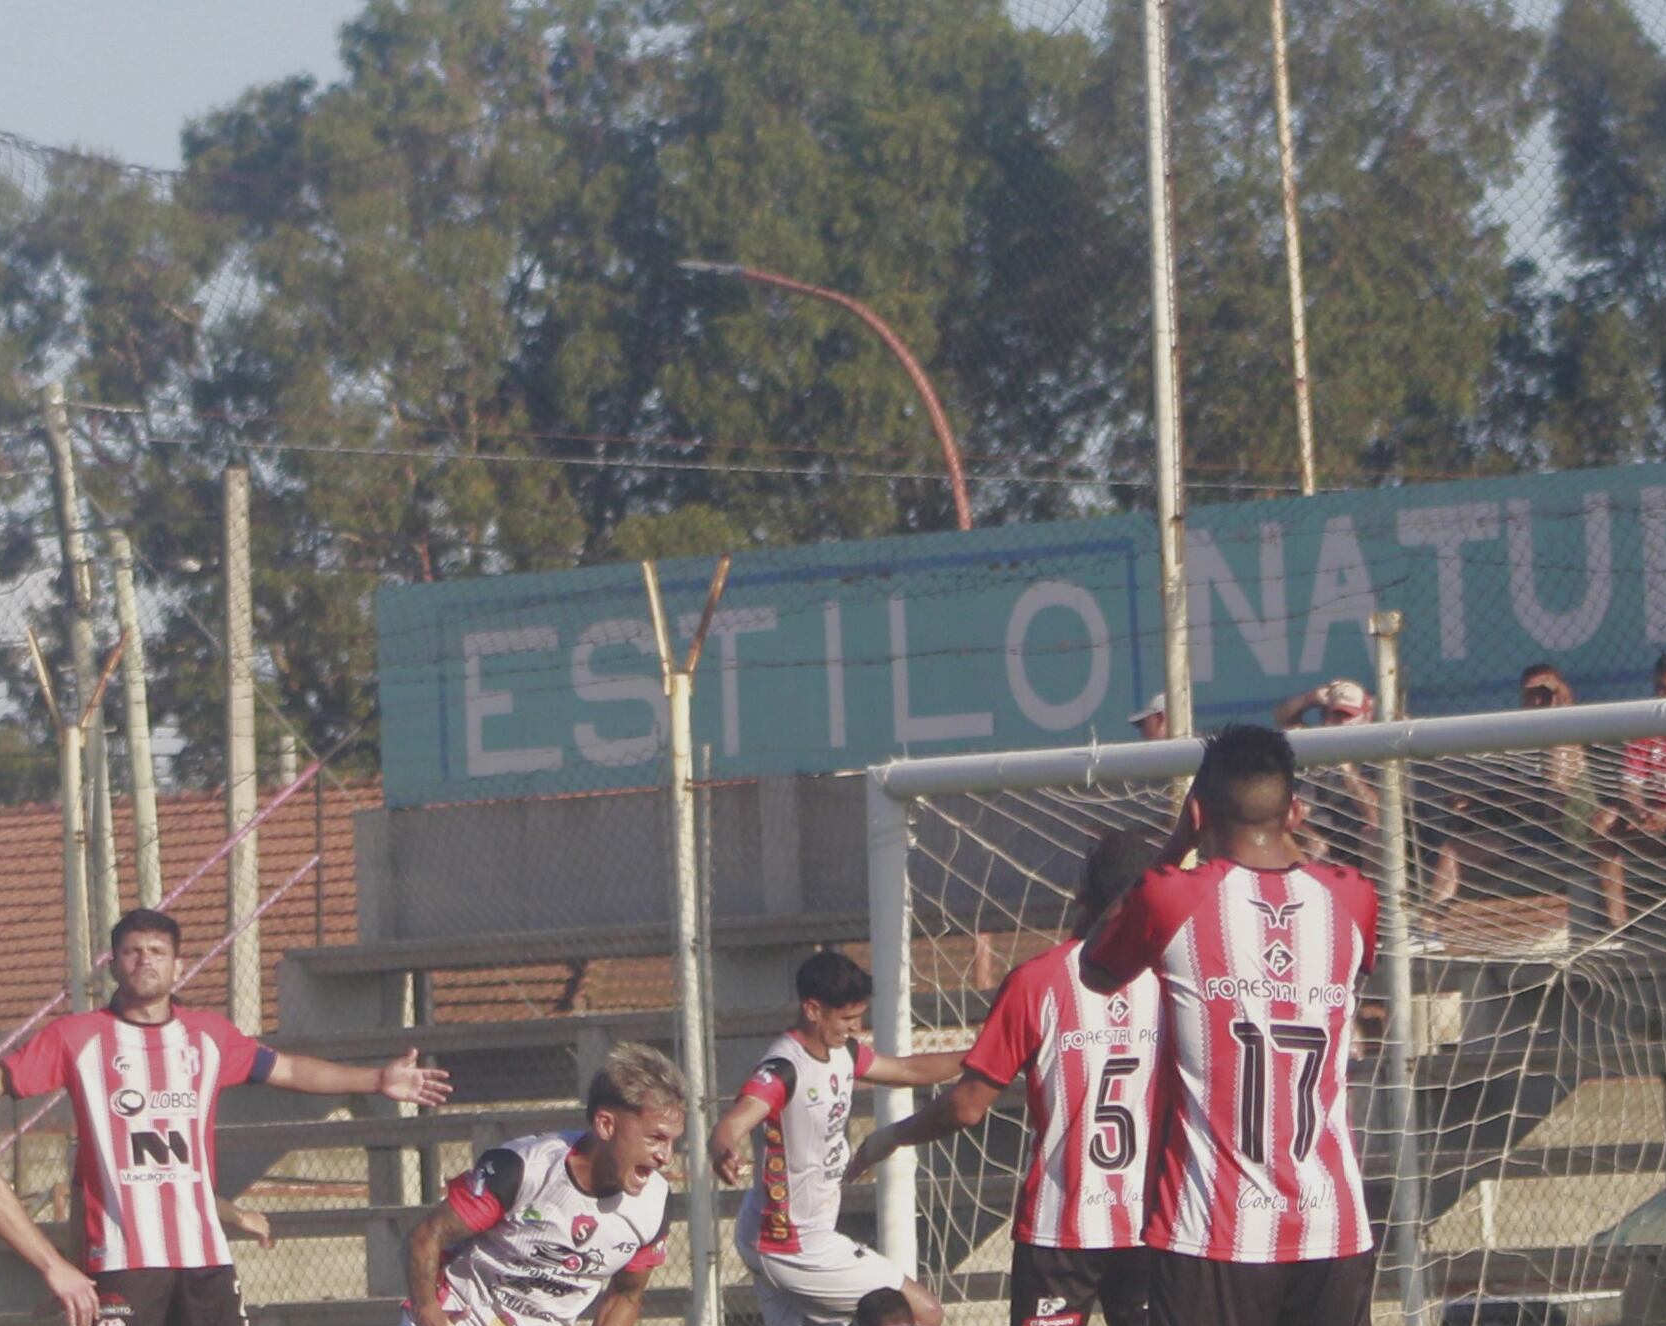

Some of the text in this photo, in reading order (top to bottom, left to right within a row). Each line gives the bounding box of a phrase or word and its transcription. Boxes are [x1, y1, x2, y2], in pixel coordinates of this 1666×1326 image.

[464, 580, 1109, 778] ESTILO
[1207, 979, 1345, 1005] FORESTAL PICO
[1061, 1029, 1134, 1050] FORESTAL
[150, 1092, 197, 1109] LOBOS
[1089, 1057, 1139, 1169] 5
[1232, 1021, 1328, 1164] 17
